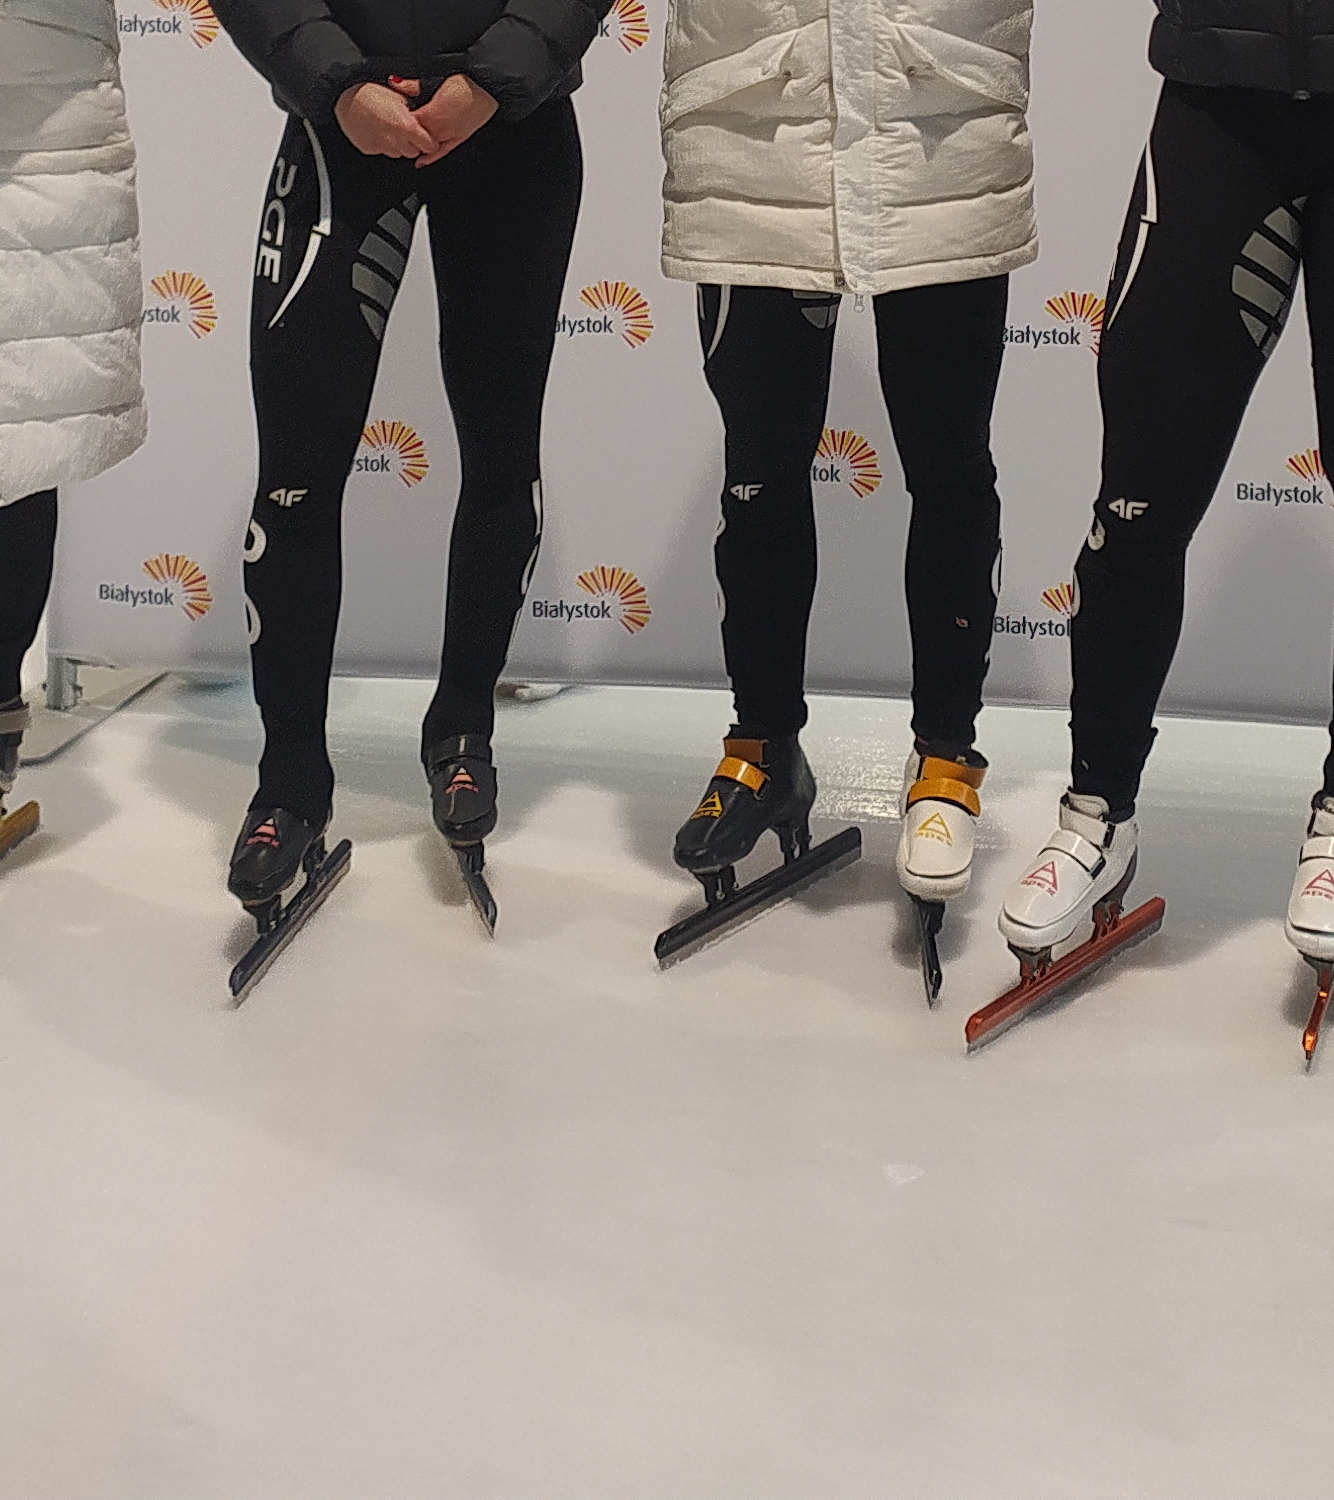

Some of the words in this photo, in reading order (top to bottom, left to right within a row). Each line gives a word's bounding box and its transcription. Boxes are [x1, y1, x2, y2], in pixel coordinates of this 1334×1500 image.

[119, 14, 183, 37] iałystok
[1236, 482, 1324, 507] Białystok
[98, 583, 175, 608] Białystok
[531, 599, 611, 622] Białystok
